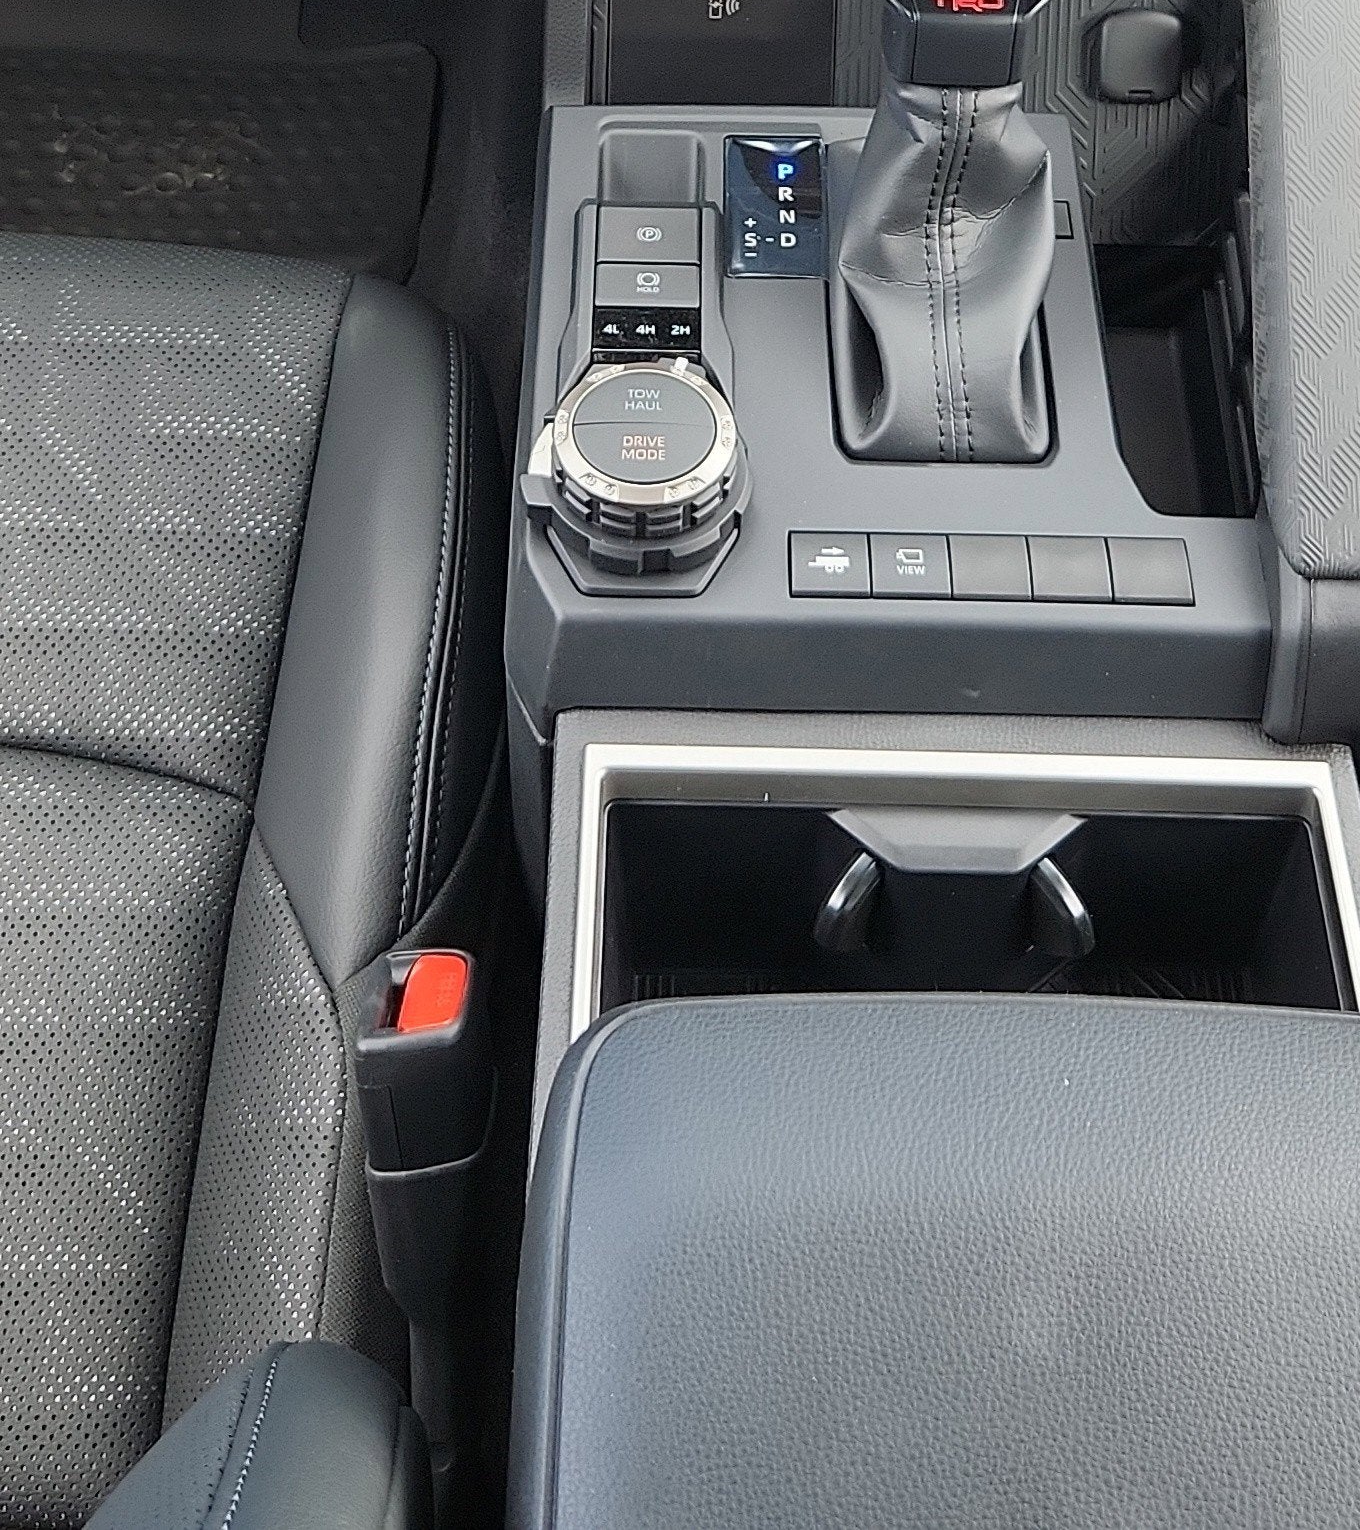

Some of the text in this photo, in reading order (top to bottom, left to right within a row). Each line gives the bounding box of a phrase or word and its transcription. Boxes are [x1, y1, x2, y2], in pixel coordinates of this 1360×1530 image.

[778, 164, 793, 179] P
[779, 186, 794, 201] R
[780, 209, 795, 224] N
[781, 233, 796, 247] D
[602, 324, 690, 335] 4L 4H 2H
[628, 388, 661, 399] TOW
[625, 400, 662, 410] HAUL
[622, 436, 666, 447] DRIVE
[622, 448, 666, 460] MODE
[896, 565, 926, 575] VIEW
